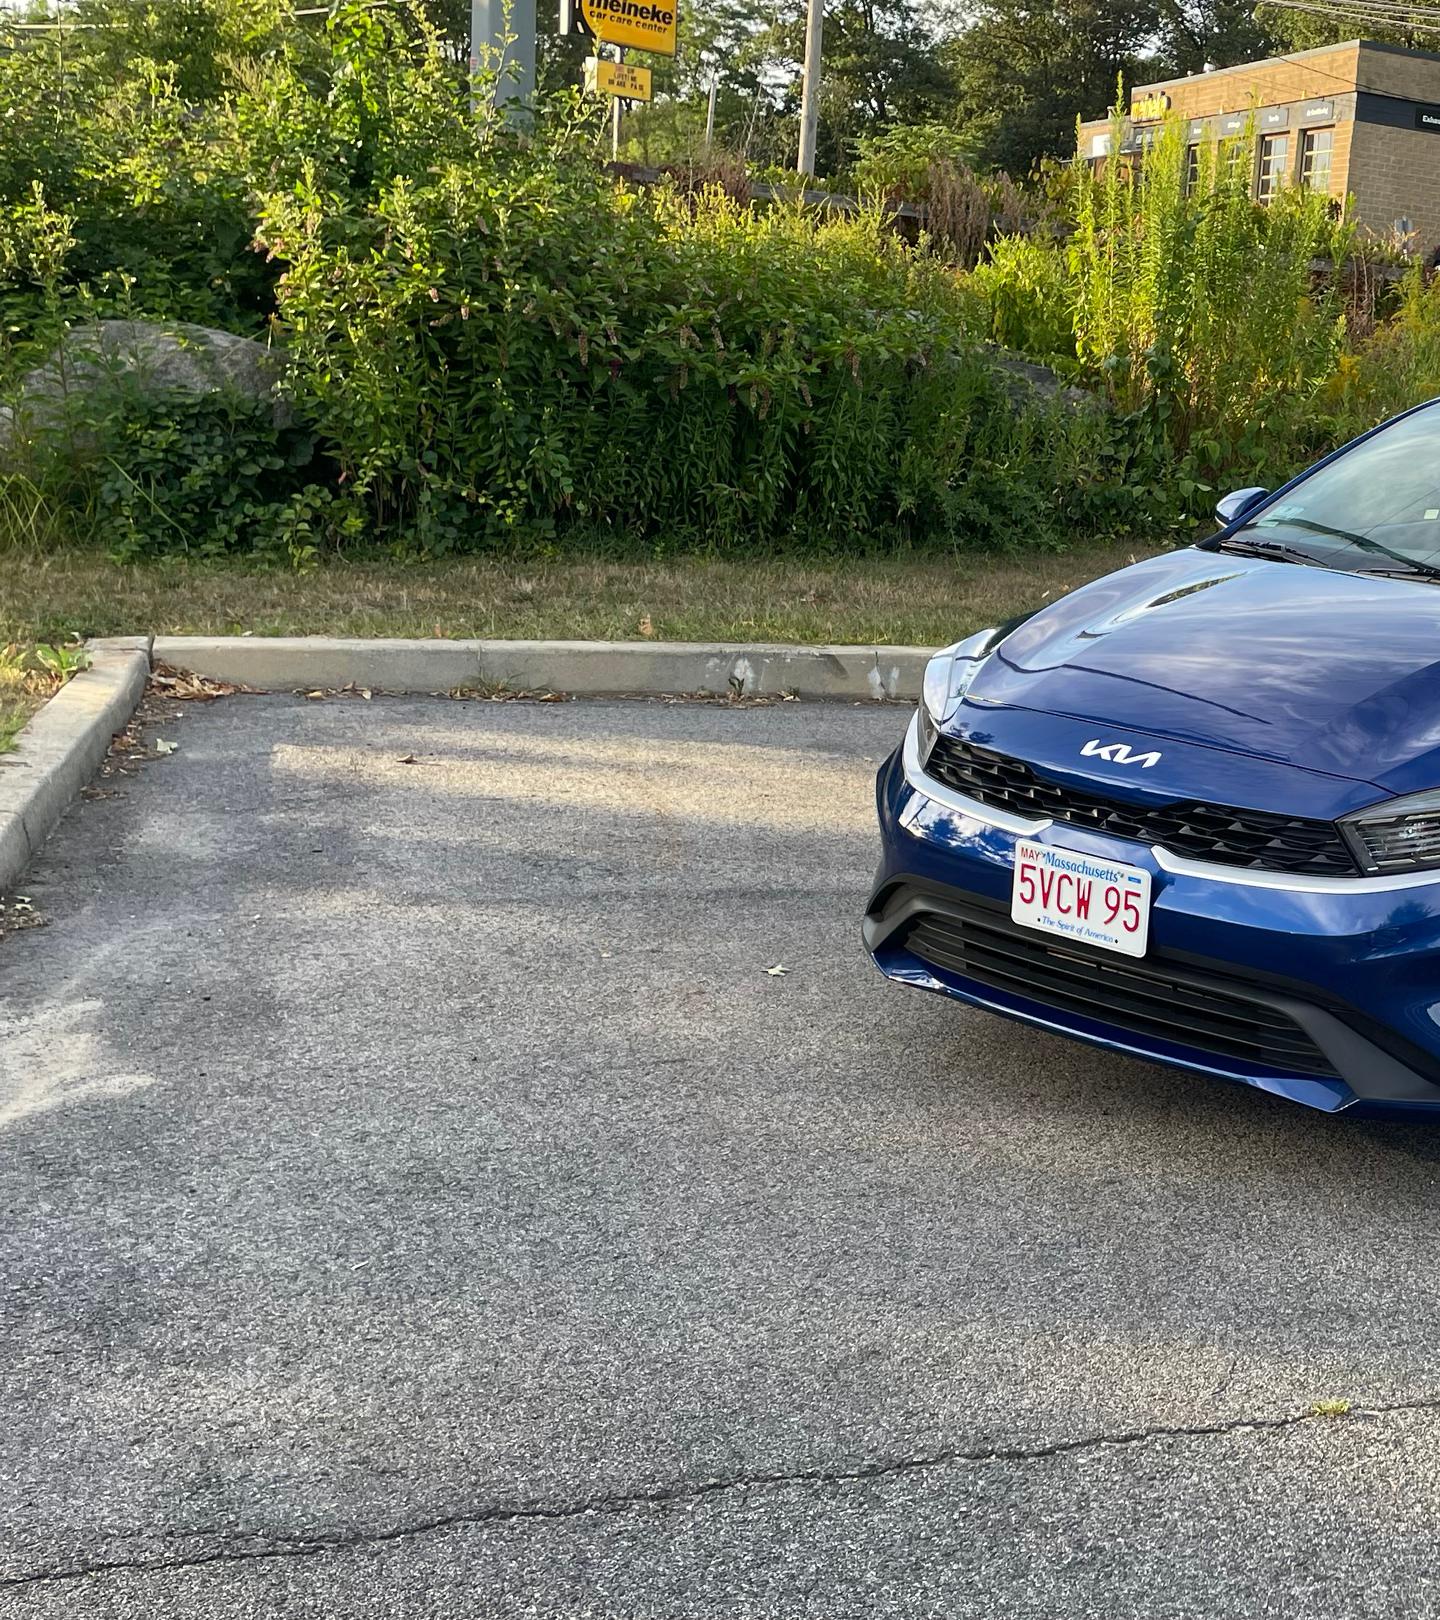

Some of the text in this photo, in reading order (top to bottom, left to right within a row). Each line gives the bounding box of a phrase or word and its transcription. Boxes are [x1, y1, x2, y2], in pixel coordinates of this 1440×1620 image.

[588, 0, 673, 25] meineke
[589, 10, 668, 33] car care center
[1080, 739, 1162, 769] KIA
[1021, 847, 1119, 883] MAY Massachusetts
[1019, 863, 1142, 933] 5VCW 95
[1042, 915, 1114, 943] The Spirit of America
